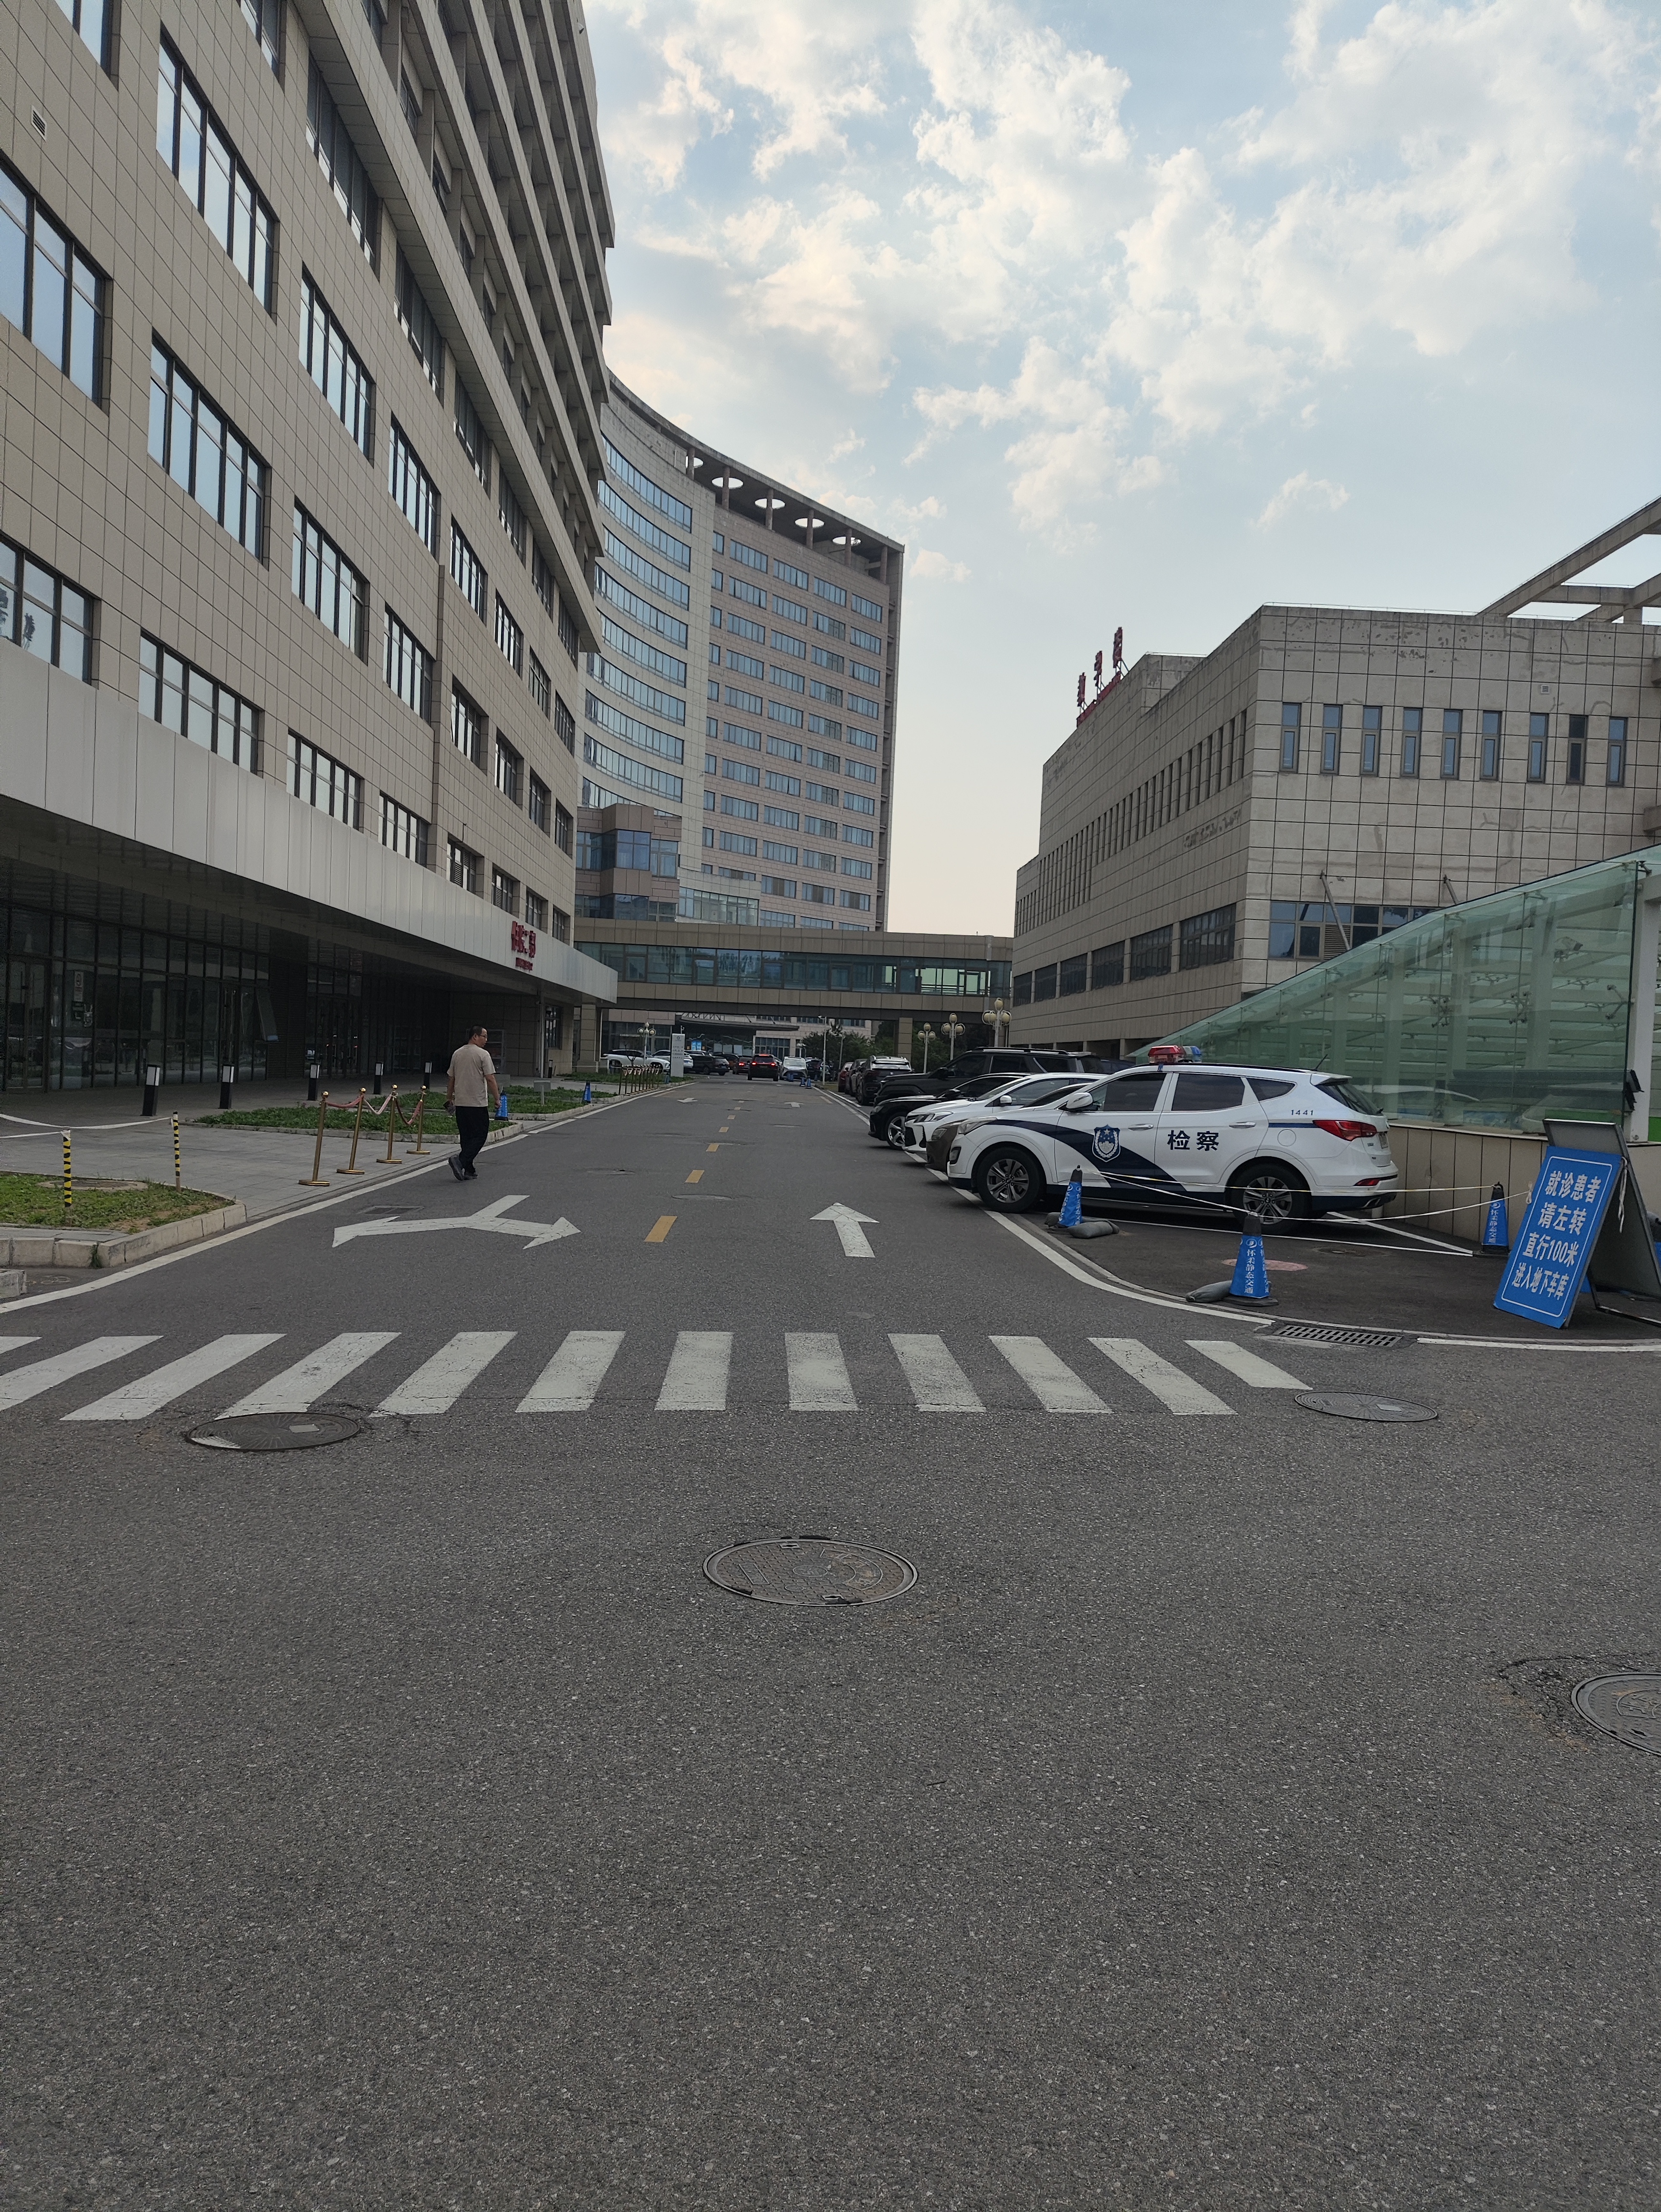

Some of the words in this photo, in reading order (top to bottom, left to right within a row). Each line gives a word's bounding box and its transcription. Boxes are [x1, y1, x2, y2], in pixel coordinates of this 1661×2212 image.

[1167, 1129, 1219, 1151] 检察
[1545, 1171, 1601, 1203] 就诊患者
[1538, 1203, 1587, 1235] 请左转
[1522, 1232, 1579, 1267] 直行100米
[1244, 1249, 1256, 1294] 怀柔静态交通
[1512, 1262, 1569, 1300] 进入地下车库
